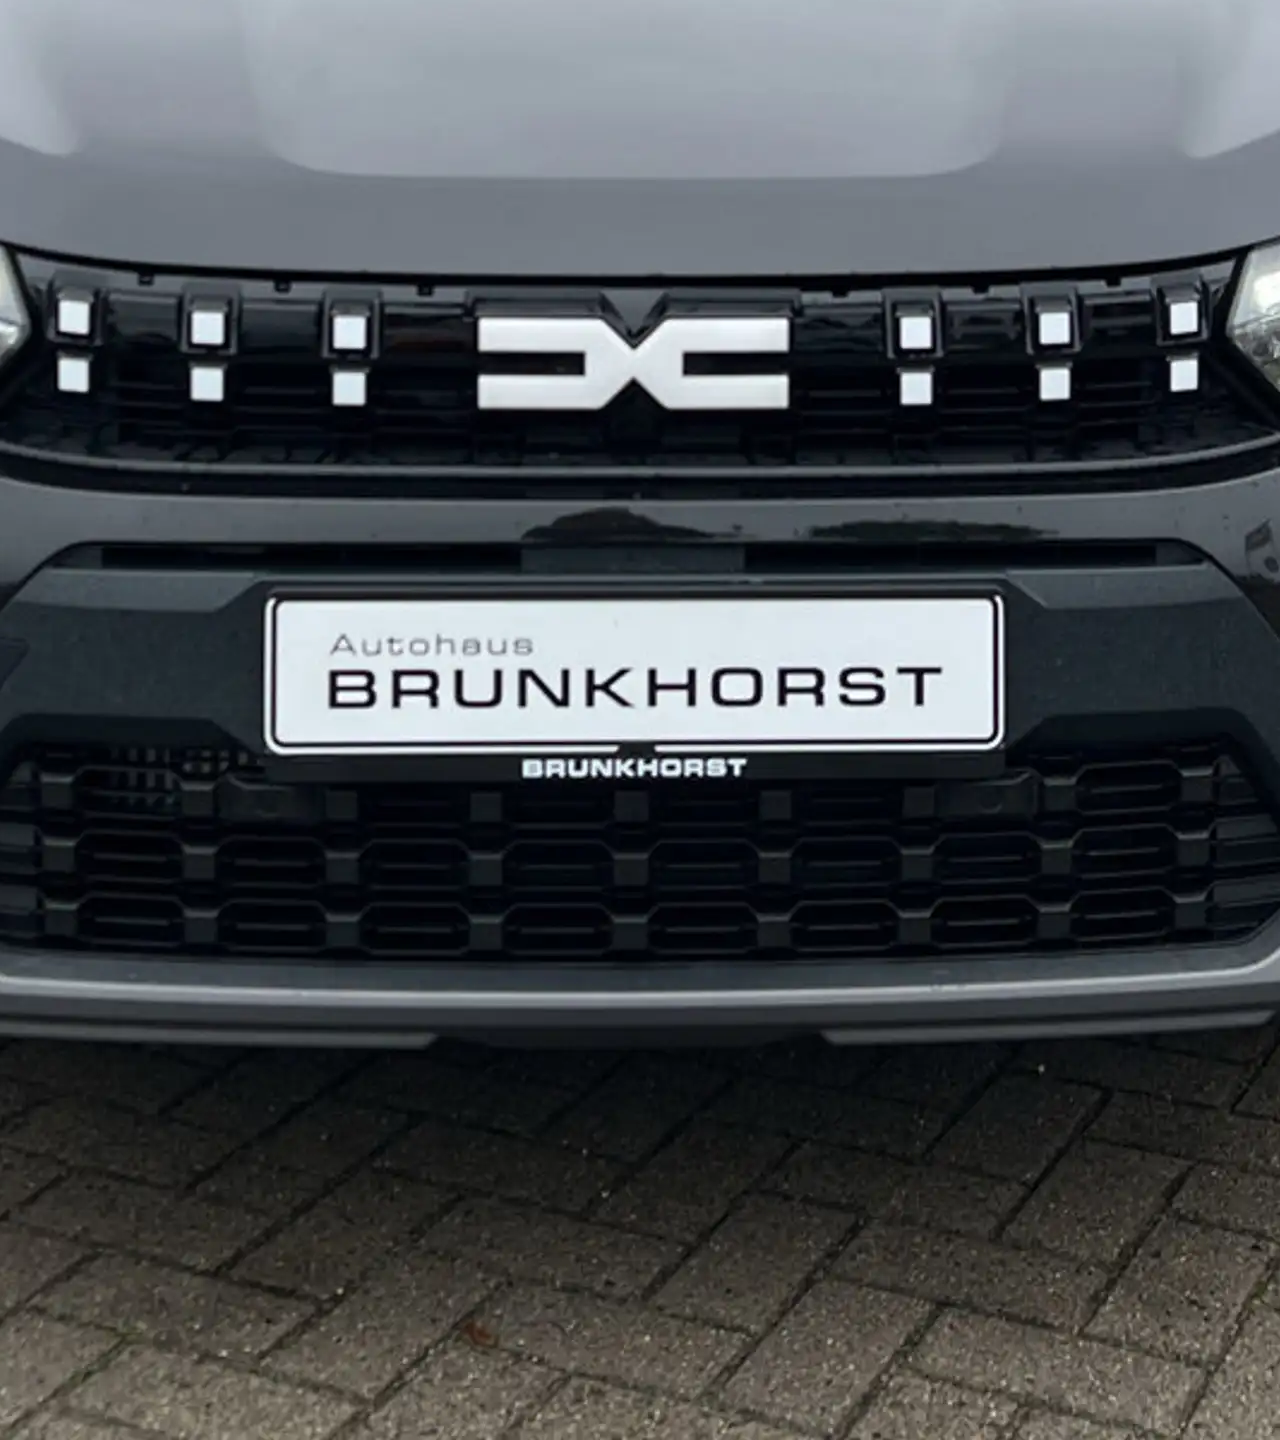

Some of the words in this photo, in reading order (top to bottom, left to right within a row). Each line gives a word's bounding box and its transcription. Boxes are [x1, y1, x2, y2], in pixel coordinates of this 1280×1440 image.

[329, 633, 534, 657] Autohaus
[328, 667, 942, 709] BRUNKHORST
[522, 759, 748, 779] BRUNKHORST
